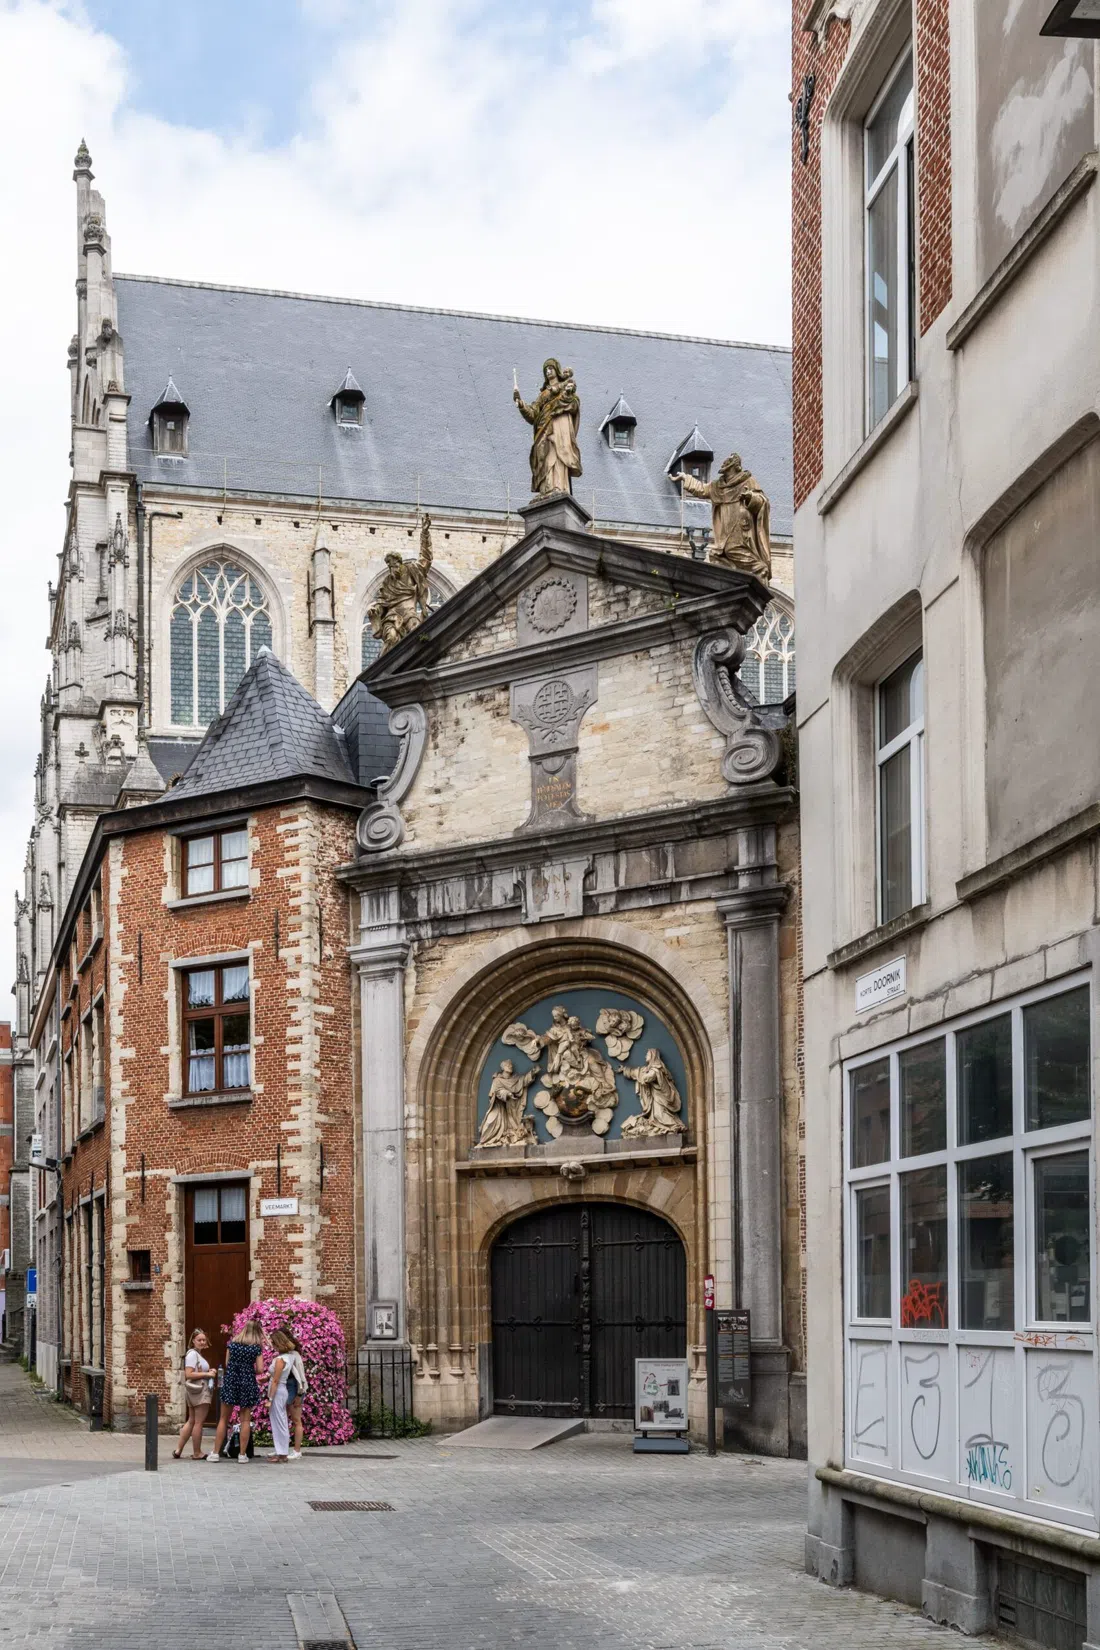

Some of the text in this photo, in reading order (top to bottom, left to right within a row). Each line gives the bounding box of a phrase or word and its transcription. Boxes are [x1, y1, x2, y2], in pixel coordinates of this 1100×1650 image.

[860, 969, 901, 997] KORTE DOORNIK
[887, 984, 901, 996] STRAAT
